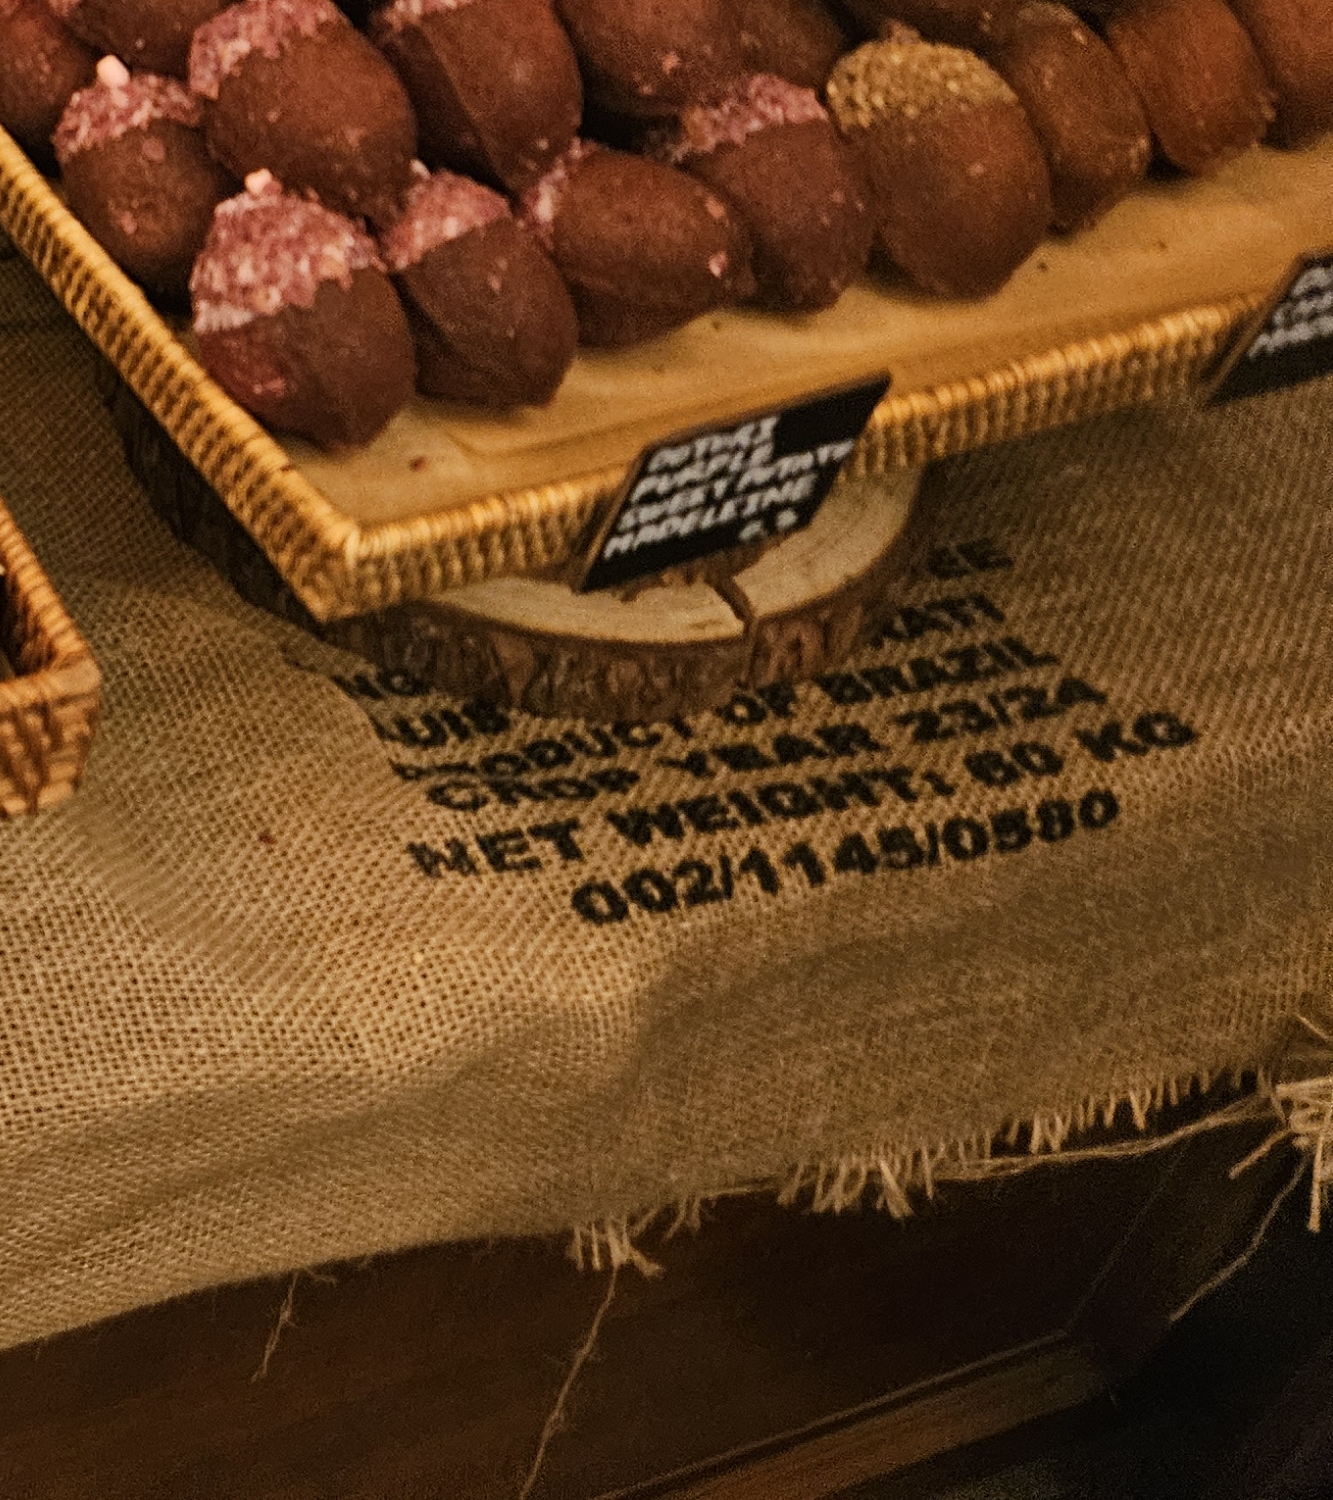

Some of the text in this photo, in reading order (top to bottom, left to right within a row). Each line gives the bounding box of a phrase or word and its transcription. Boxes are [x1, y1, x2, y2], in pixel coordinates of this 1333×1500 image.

[656, 722, 882, 779] YEAR
[893, 677, 1108, 743] 23/24
[811, 635, 1062, 705] BRAZIL
[406, 711, 1200, 877] NET WEIGHT: 60 KG
[572, 788, 1121, 925] 002/1145/0580
